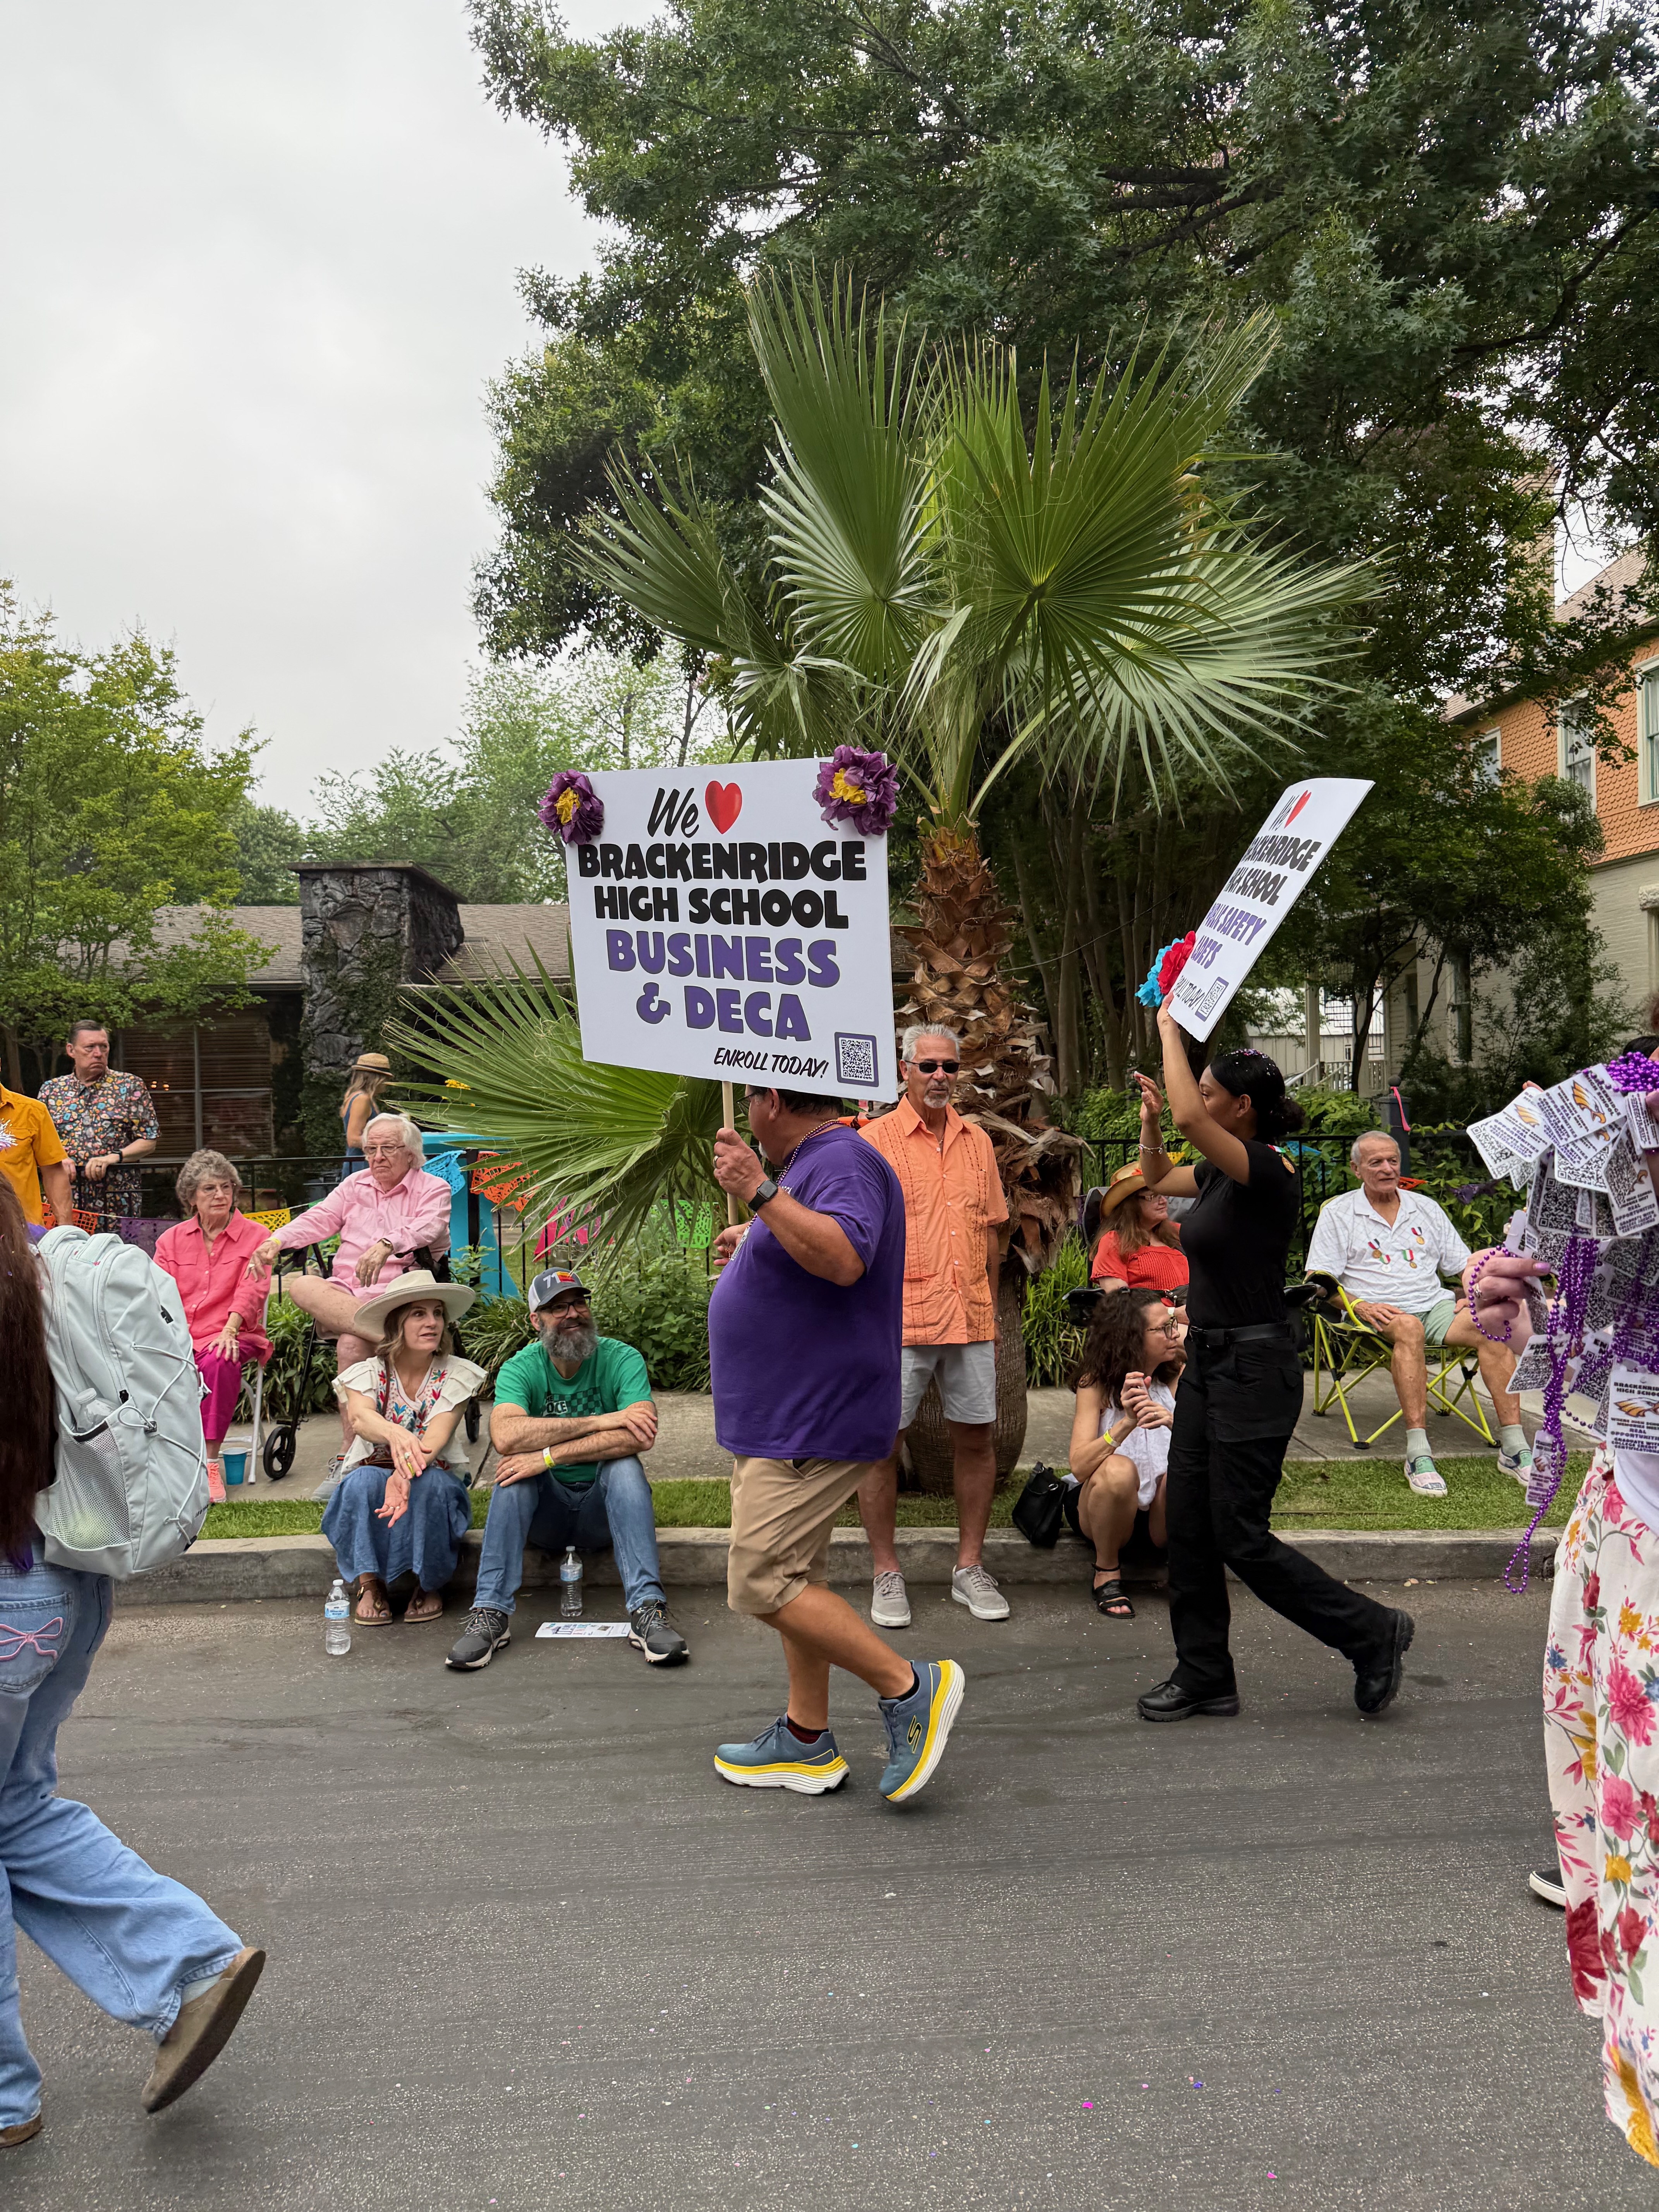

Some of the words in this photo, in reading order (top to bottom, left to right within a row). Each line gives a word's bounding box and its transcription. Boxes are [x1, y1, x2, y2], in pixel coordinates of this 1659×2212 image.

[647, 787, 699, 837] We
[579, 841, 867, 883] BRACKENRIDGE
[1239, 835, 1322, 872] ACKENRIDGE
[1236, 868, 1288, 906] SCHOOL
[594, 886, 679, 922] HIGH
[689, 888, 848, 929] SCHOOL
[1217, 907, 1267, 946] SAFETY
[606, 929, 841, 988] BUSINESS
[636, 982, 671, 1024] &
[684, 986, 812, 1041] DECA
[1180, 982, 1205, 1010] TODAY!
[714, 1048, 768, 1071] ENROLL
[771, 1054, 830, 1079] TODAY!
[1589, 1070, 1621, 1115] ACKENRIDGE
[1596, 1091, 1614, 1116] SCHOOL
[1545, 1092, 1577, 1138] OPPORTUNITIES
[1560, 1104, 1572, 1120] REAL
[1494, 1118, 1539, 1153] OPPORTUNITIES
[1512, 1127, 1527, 1139] REAL
